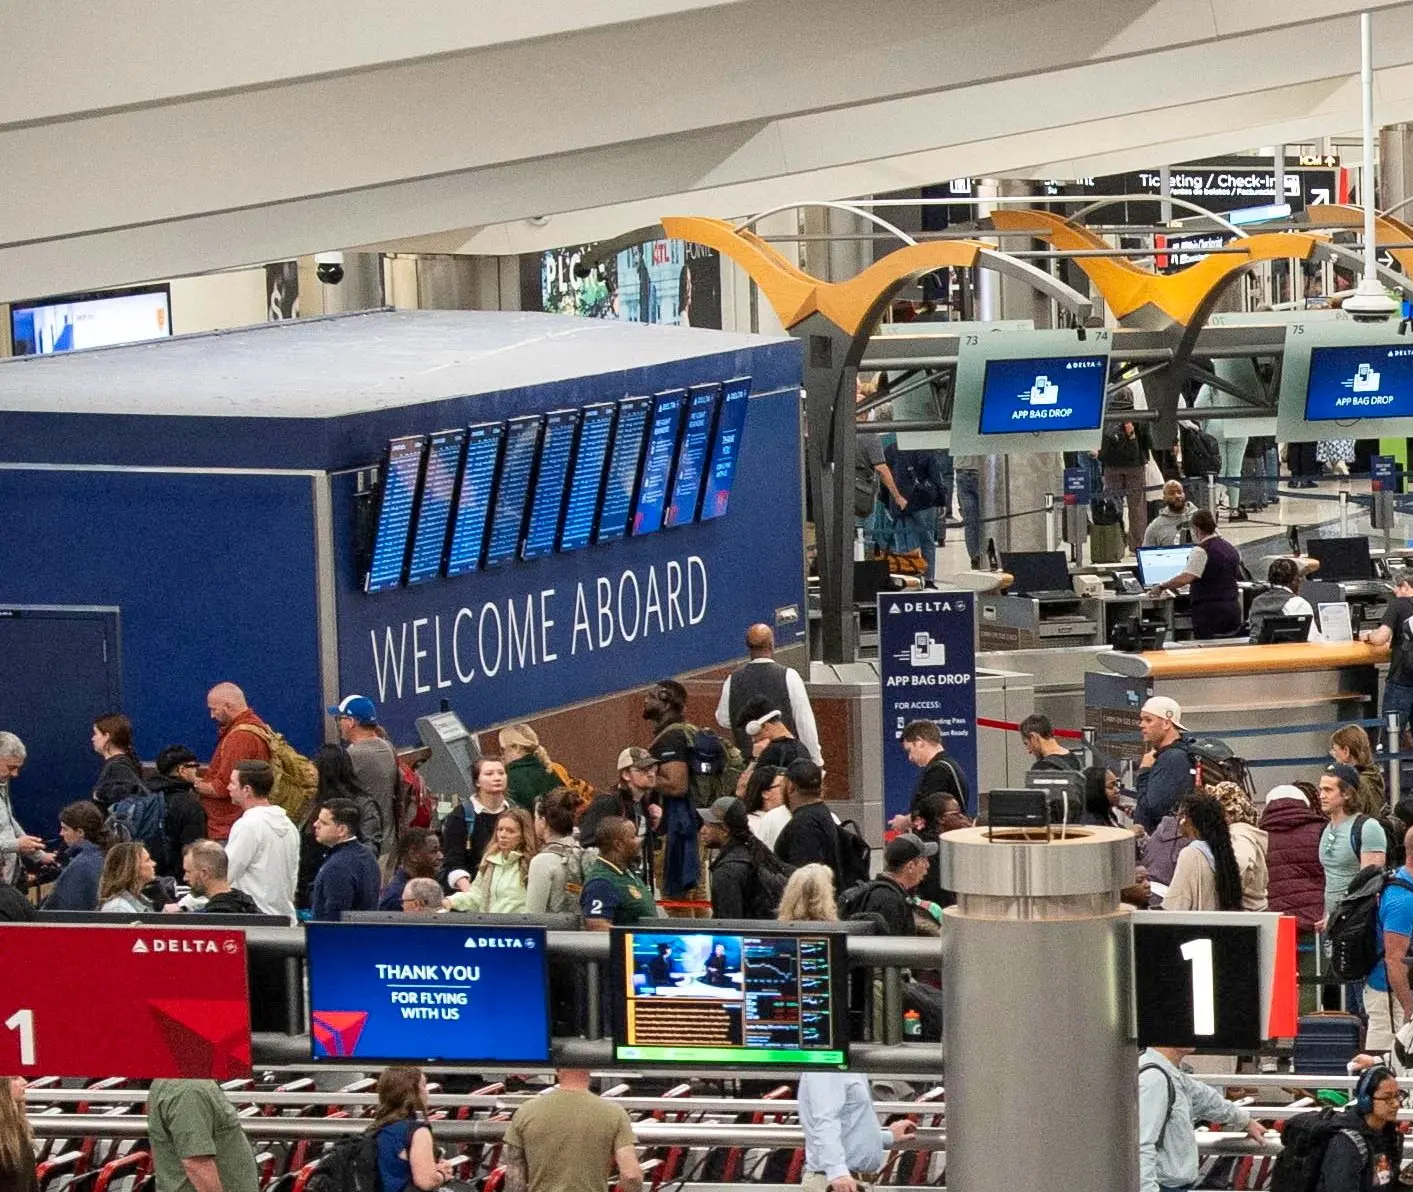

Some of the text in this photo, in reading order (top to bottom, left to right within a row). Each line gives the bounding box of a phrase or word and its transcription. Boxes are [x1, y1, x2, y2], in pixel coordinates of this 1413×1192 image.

[1139, 173, 1203, 188] Ticeting
[1096, 331, 1107, 341] 74
[1292, 325, 1304, 335] 75
[966, 336, 978, 345] 73
[1336, 396, 1393, 406] APP BAG DROP
[1012, 408, 1073, 419] APP BAG DROP
[904, 602, 952, 612] DELTA
[370, 556, 707, 703] WELCOME ABOARD
[887, 674, 971, 686] APP BAG DROP
[911, 701, 940, 709] ACCESS:
[590, 899, 603, 914] 2
[153, 939, 219, 953] DELTA
[479, 938, 523, 948] DELTA
[375, 964, 480, 981] THANK YOU
[1180, 938, 1215, 1036] 1
[391, 991, 468, 1005] FOR FLYING
[401, 1007, 460, 1020] WITH US
[4, 1008, 36, 1066] 1
